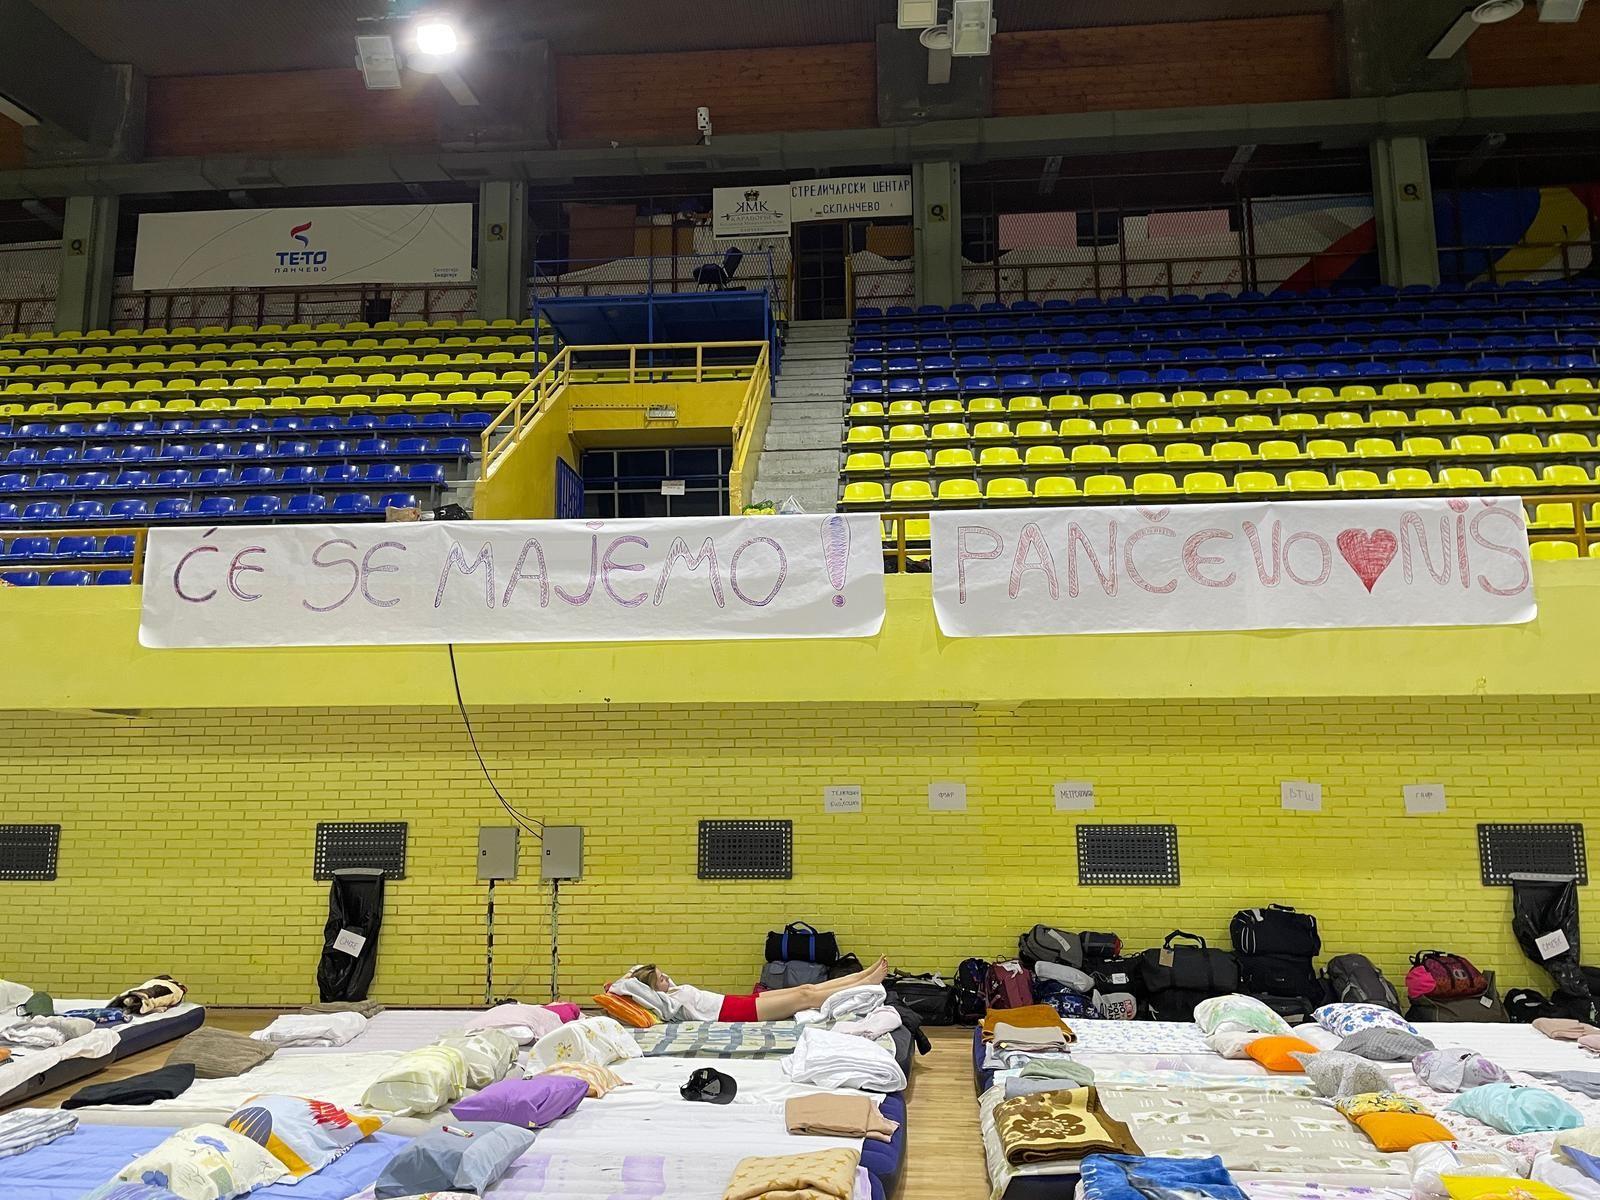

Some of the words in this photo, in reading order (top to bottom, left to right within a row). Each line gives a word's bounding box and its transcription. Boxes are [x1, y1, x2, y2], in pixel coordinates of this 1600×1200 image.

[791, 182, 866, 198] СТРЕЛИЧАРСКИ
[872, 180, 910, 193] ЦЕНТАР
[303, 538, 406, 612] SE
[434, 521, 787, 608] MAJEMO
[958, 507, 1332, 604] PANČEVO
[1289, 787, 1314, 802] ВТШ
